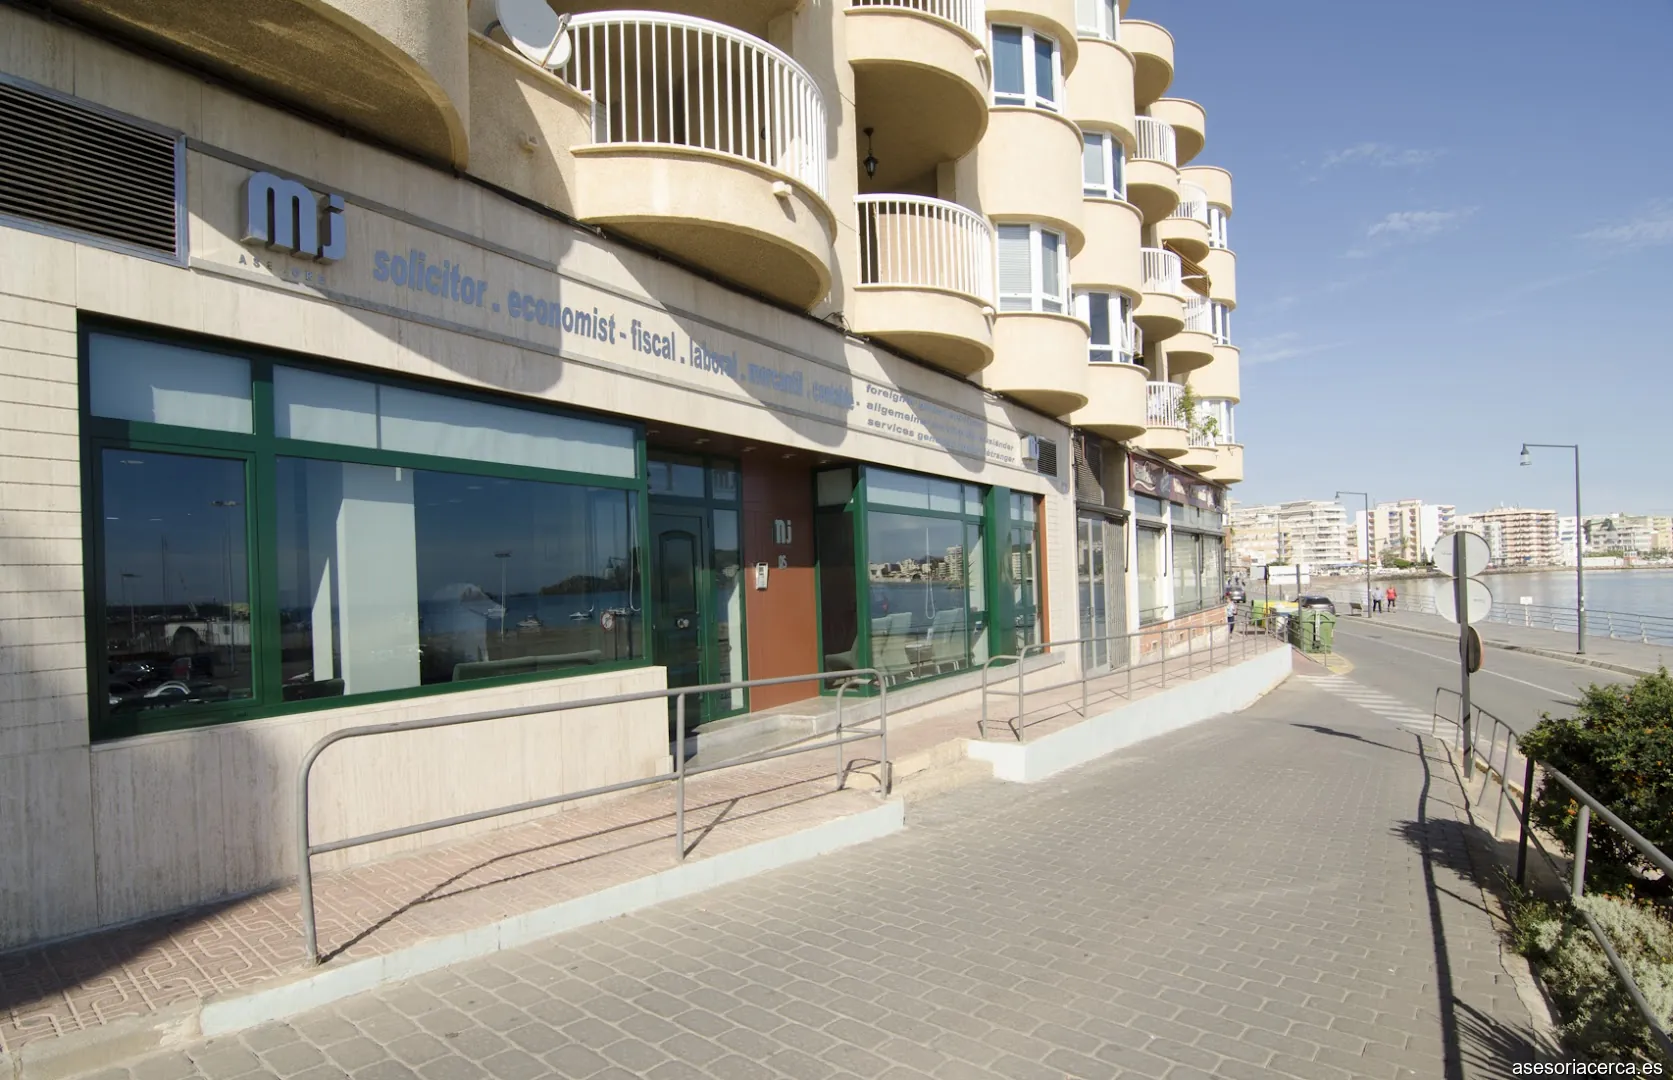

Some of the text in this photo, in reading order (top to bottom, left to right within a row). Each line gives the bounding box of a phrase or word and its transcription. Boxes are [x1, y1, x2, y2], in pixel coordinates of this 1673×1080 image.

[373, 248, 488, 307] solicitor
[507, 290, 616, 345] economist
[630, 318, 676, 361] fiscal
[689, 337, 738, 380] laboral
[868, 418, 914, 437] services
